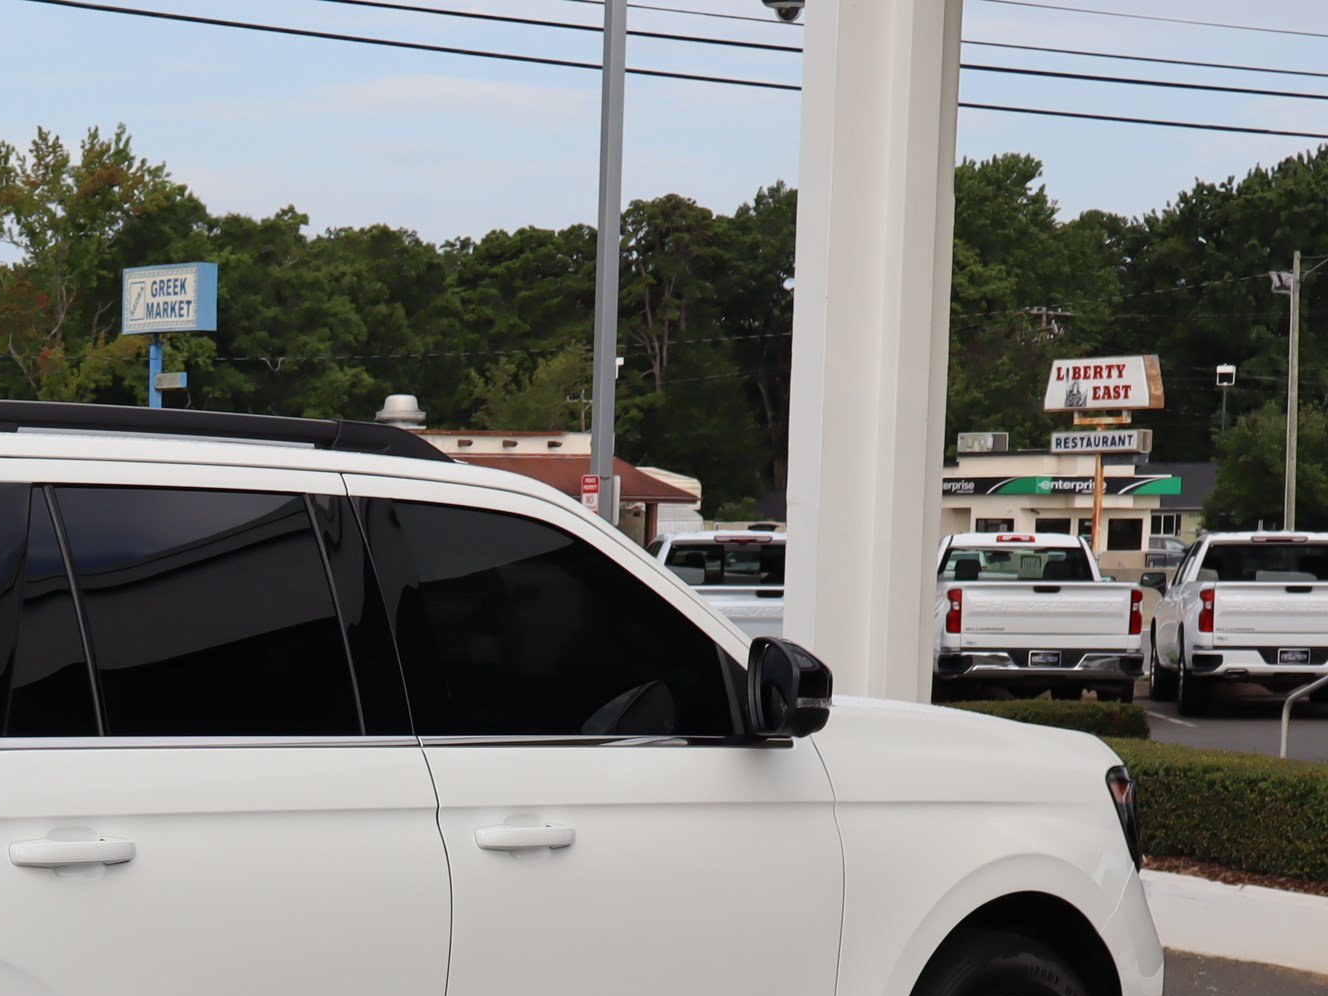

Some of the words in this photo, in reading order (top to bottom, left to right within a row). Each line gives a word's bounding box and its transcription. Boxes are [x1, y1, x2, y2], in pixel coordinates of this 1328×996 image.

[151, 277, 187, 298] GREEK
[146, 300, 192, 319] MARKET
[1092, 385, 1132, 400] EAST
[1055, 434, 1134, 450] RESTAURANT
